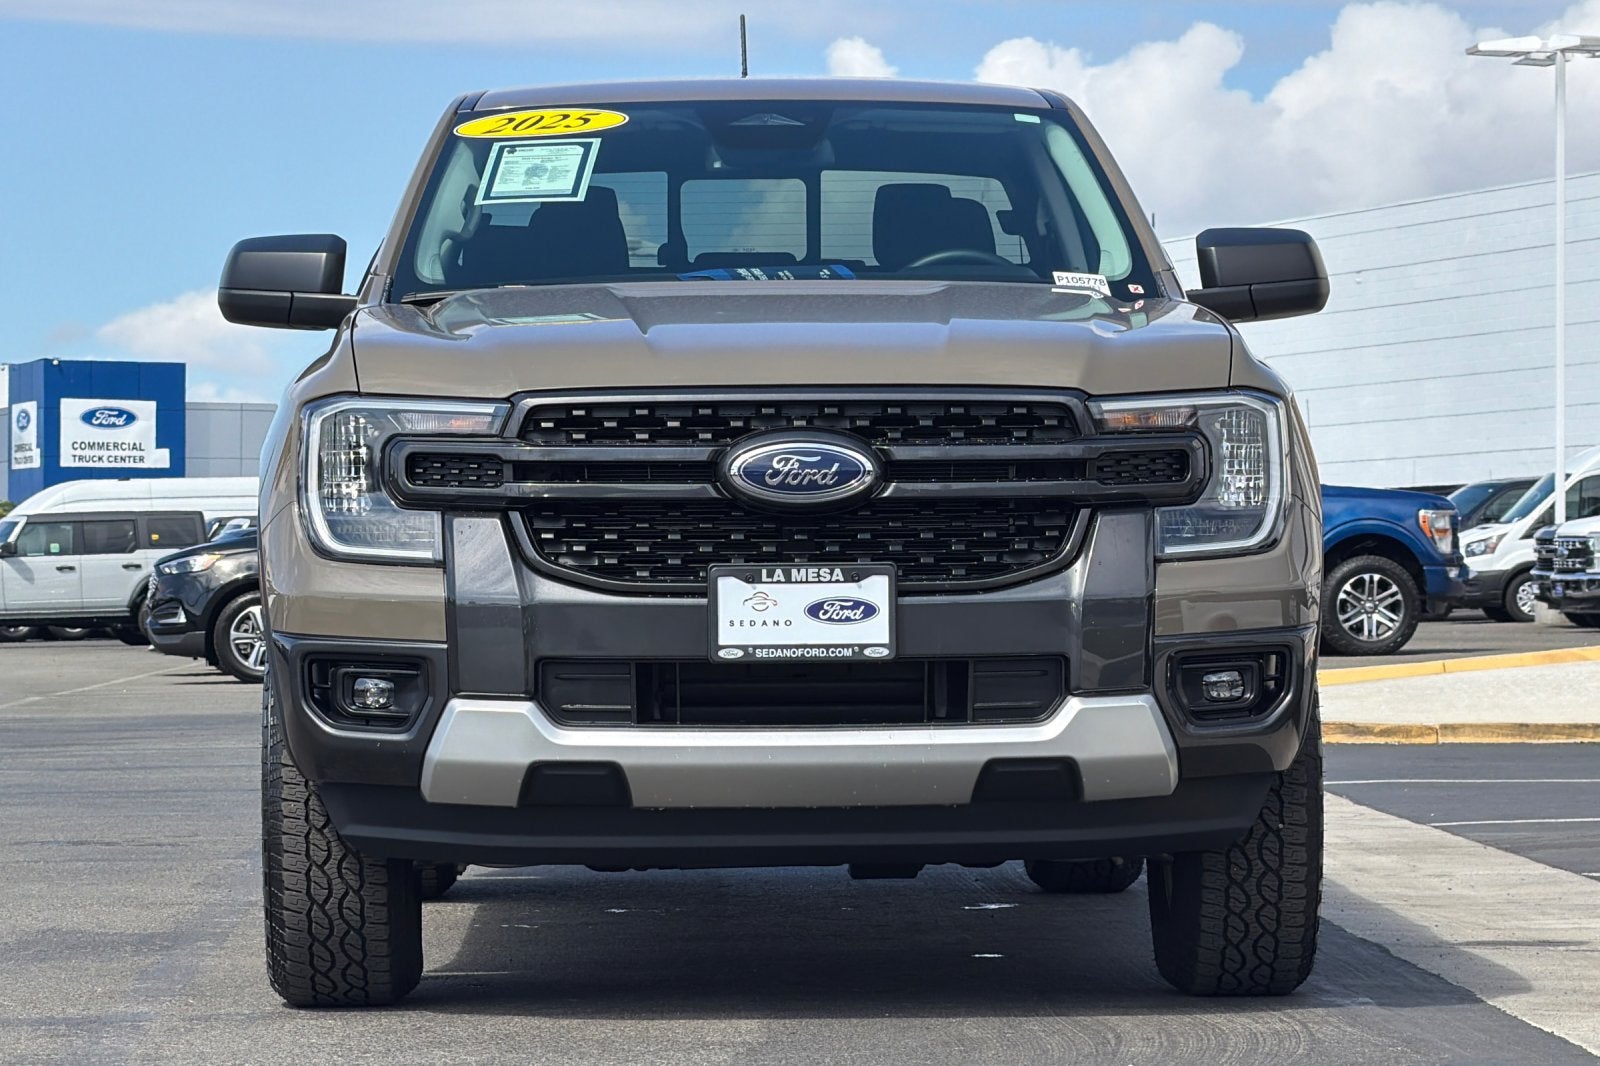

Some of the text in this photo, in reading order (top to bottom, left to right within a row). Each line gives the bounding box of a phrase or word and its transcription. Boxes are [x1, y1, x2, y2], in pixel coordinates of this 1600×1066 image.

[482, 113, 602, 134] 2025
[1056, 275, 1107, 287] P105778
[91, 409, 128, 426] Ford
[71, 441, 145, 452] COMMERCIAL
[71, 454, 145, 464] TRUCK CENTER
[764, 454, 841, 486] Ford
[761, 568, 844, 583] LA MESA
[818, 600, 865, 620] Ford
[729, 619, 792, 627] SEDANO
[755, 647, 853, 658] SEDANOFORD.COM
